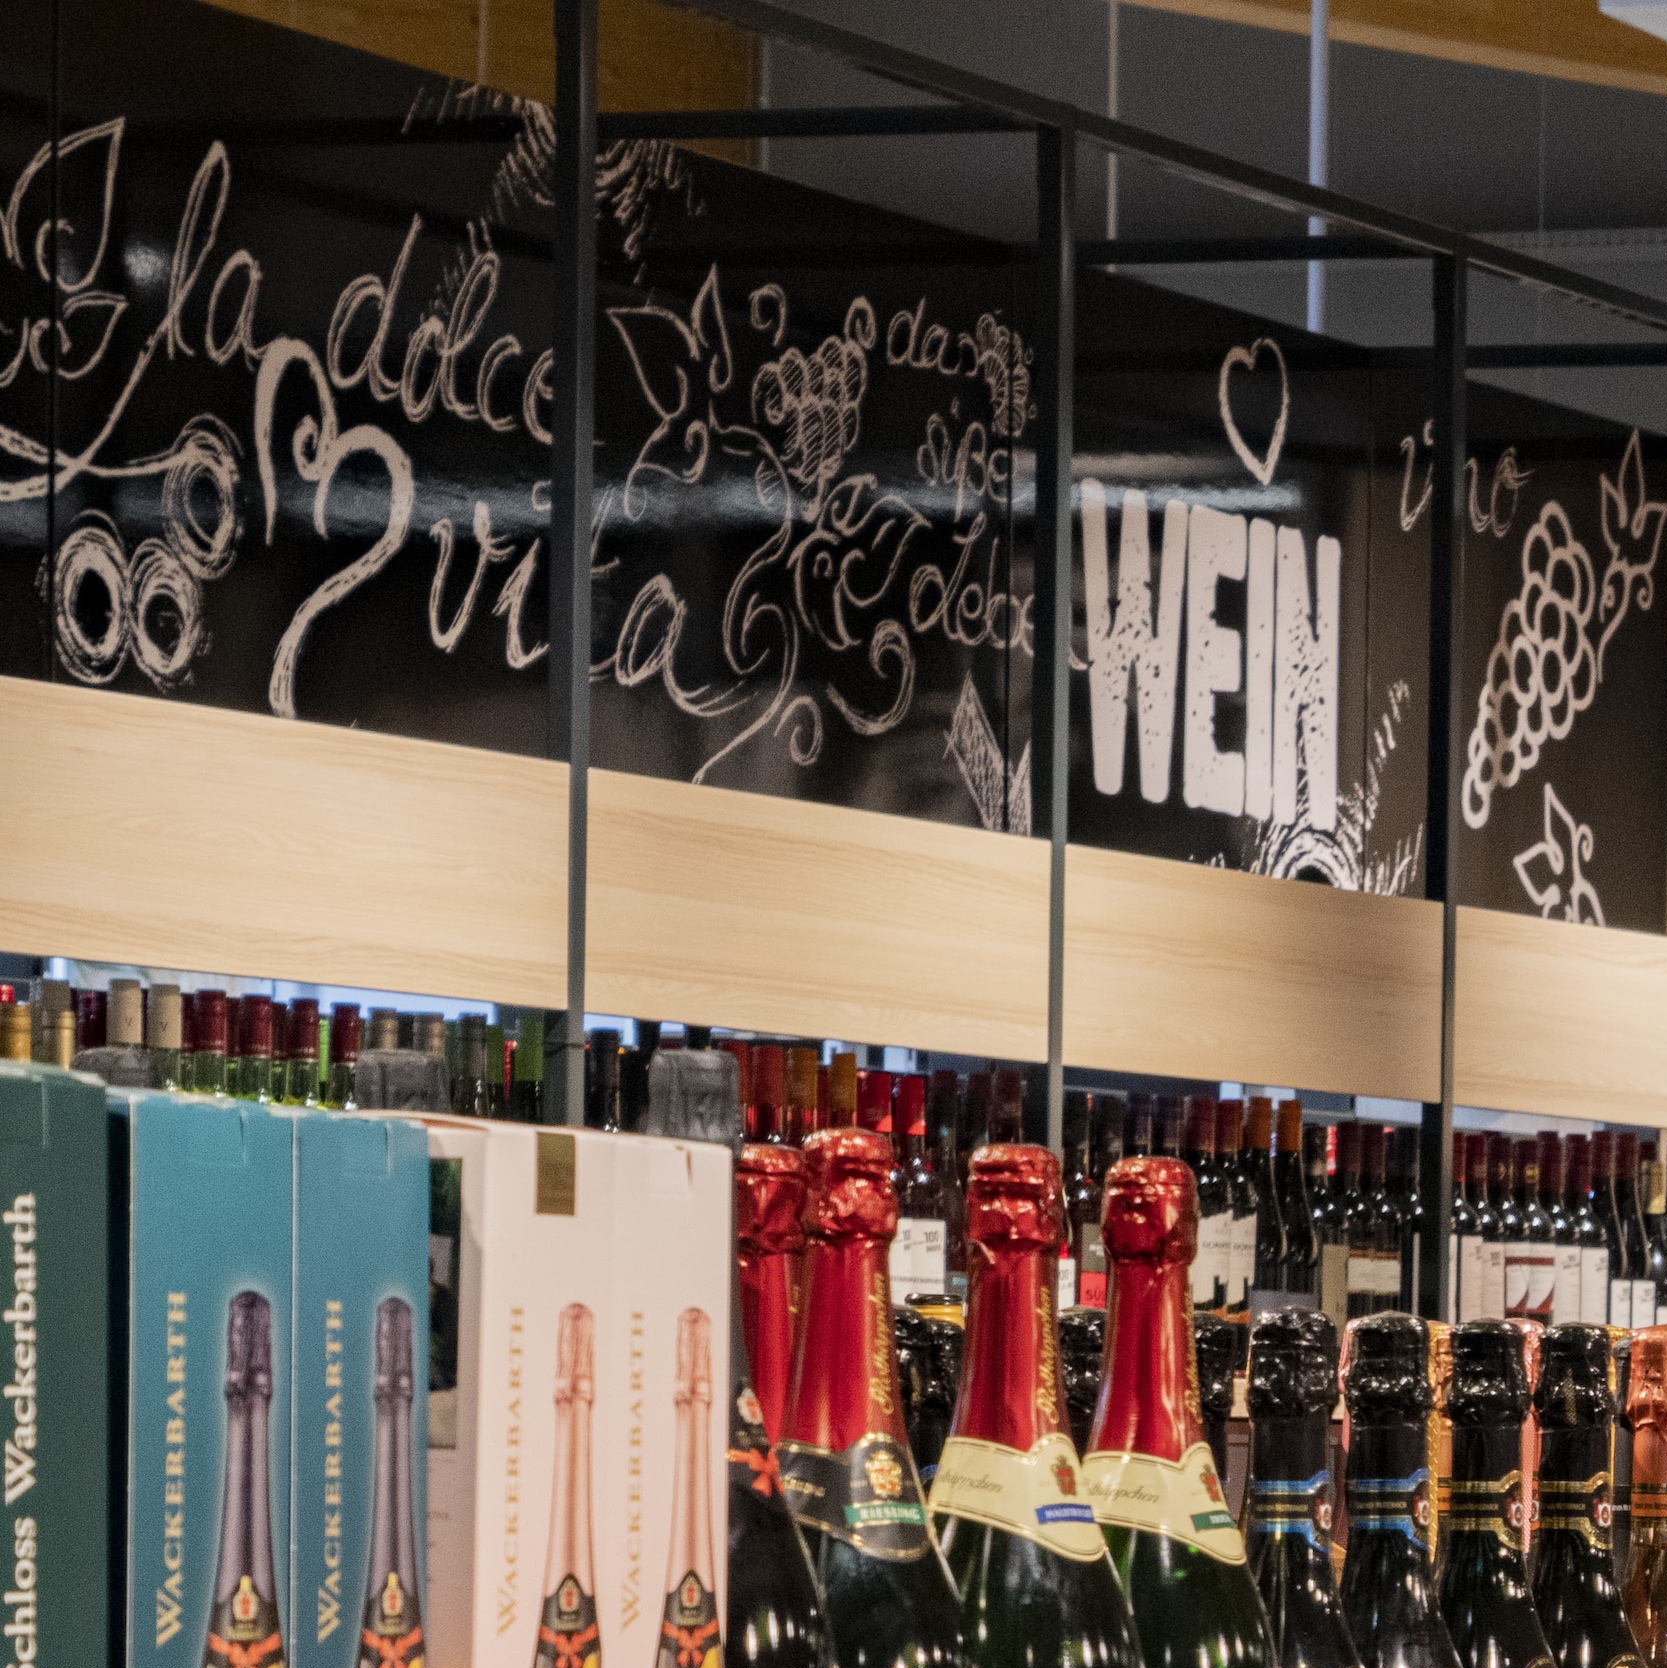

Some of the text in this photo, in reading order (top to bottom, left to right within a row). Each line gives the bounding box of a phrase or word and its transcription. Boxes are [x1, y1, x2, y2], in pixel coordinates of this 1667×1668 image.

[1081, 477, 1342, 832] WEIN
[2, 1191, 38, 1506] Wackerbarth
[155, 1291, 187, 1648] WACKERBARTH
[316, 1299, 343, 1644] WACKERBARTH
[496, 1305, 525, 1639] WACKERBARTH
